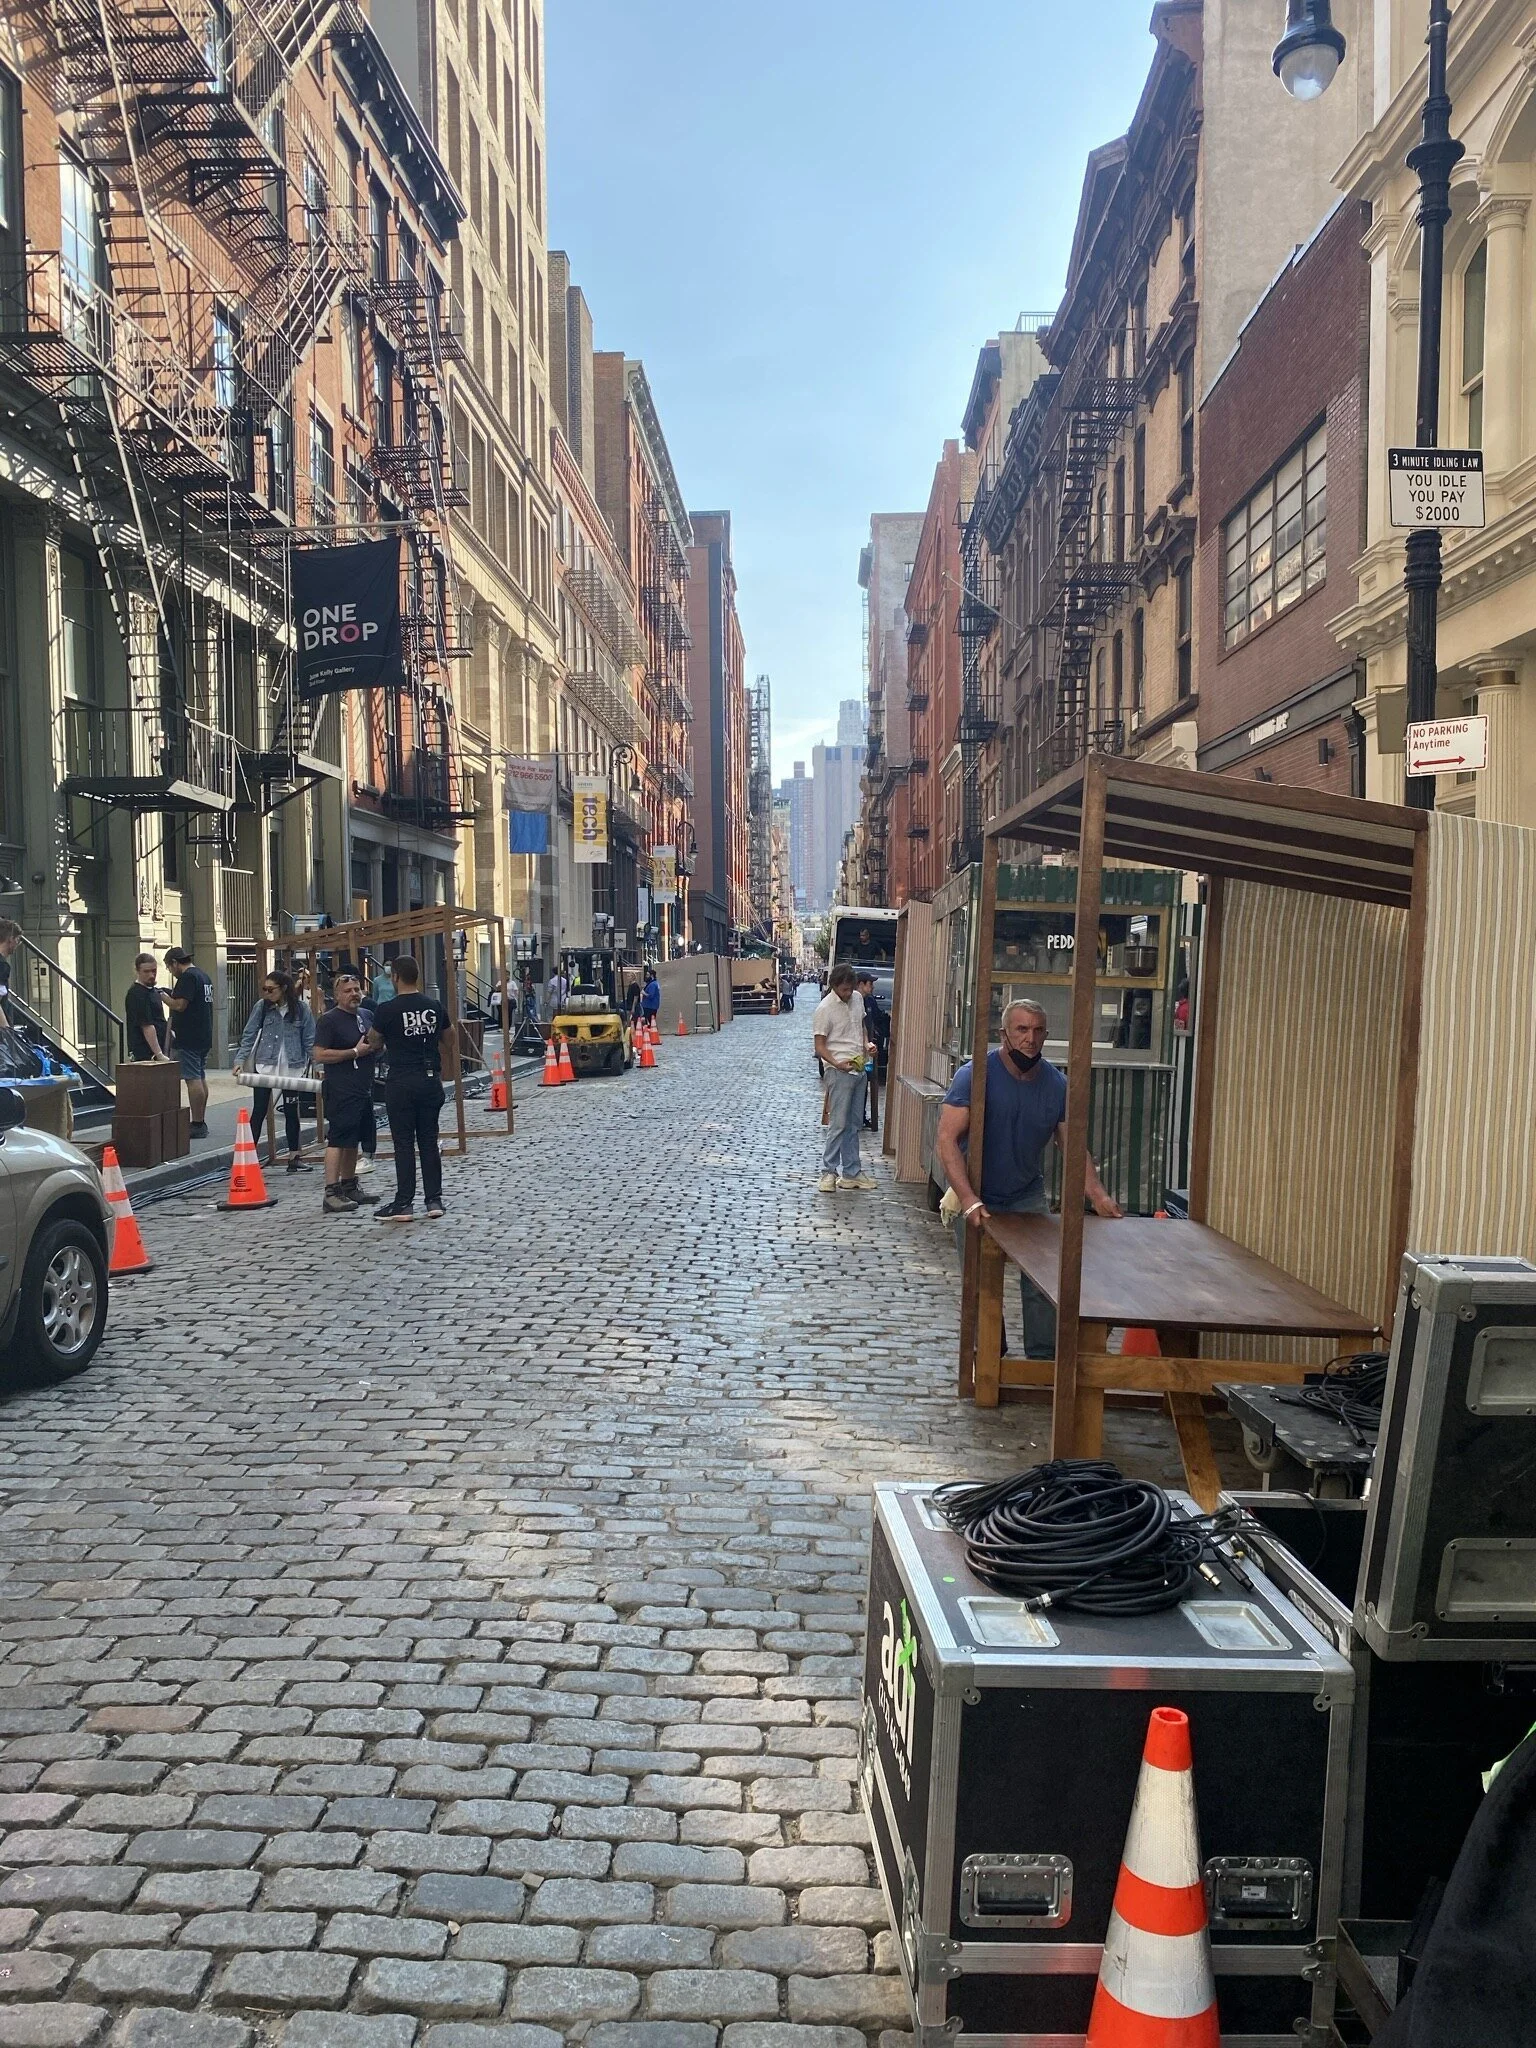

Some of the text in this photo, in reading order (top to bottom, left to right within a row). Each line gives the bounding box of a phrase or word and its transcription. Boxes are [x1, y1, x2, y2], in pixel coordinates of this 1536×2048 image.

[1393, 453, 1479, 468] 3 MINUTE IDLING LAW
[1406, 474, 1467, 487] YOU IDLE
[1409, 490, 1465, 503] YOU PAY
[1416, 506, 1460, 521] $2000
[303, 603, 357, 629] ONE
[303, 622, 379, 651] DROP
[1413, 723, 1469, 739] NO PARKING
[1413, 738, 1450, 751] Anytime
[582, 796, 604, 840] tech
[404, 1025, 437, 1037] CREW
